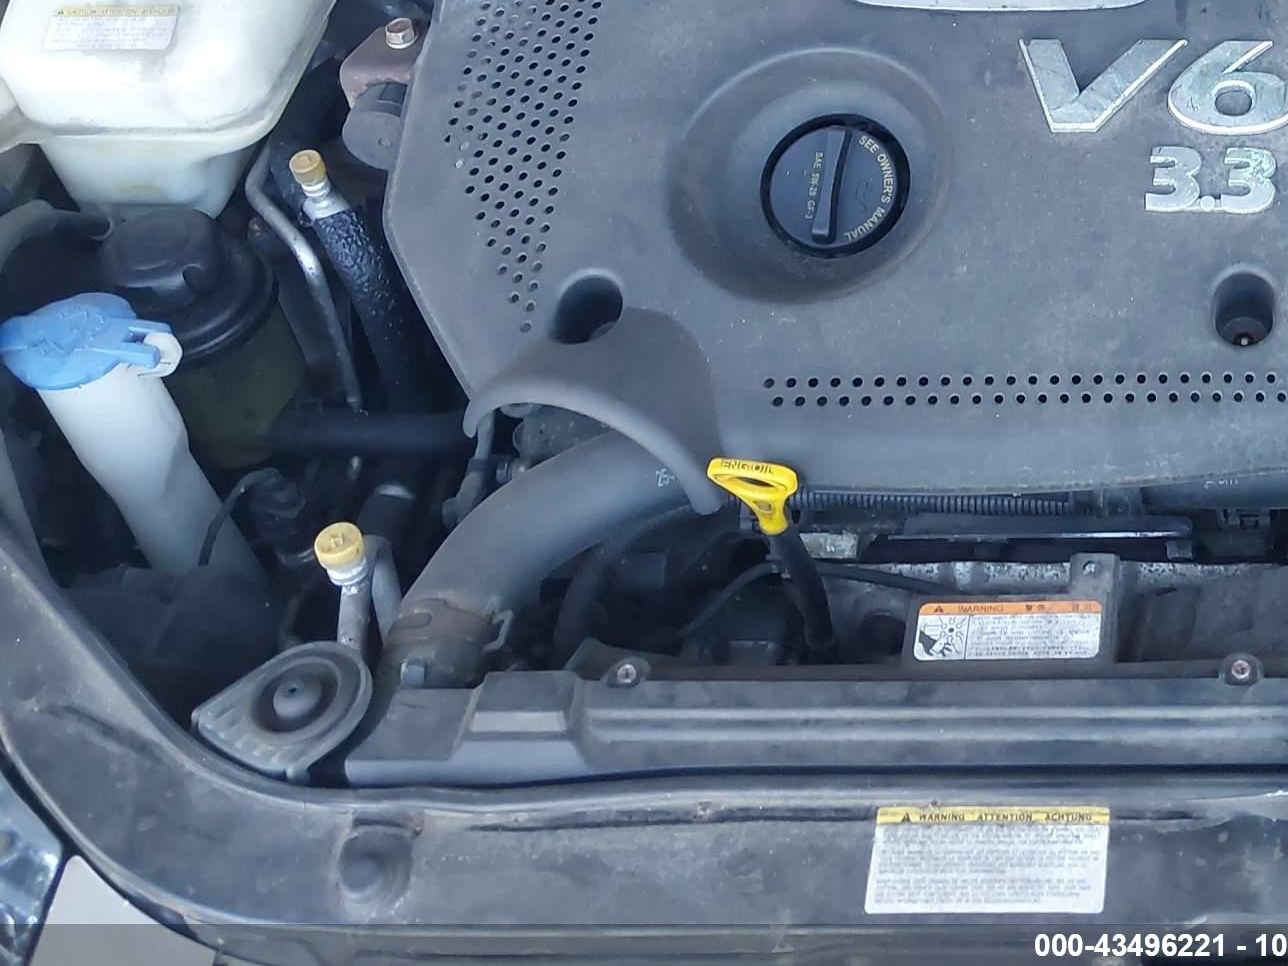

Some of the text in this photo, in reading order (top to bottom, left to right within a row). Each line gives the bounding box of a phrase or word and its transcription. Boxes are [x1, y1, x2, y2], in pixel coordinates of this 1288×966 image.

[845, 135, 893, 242] SEE OWNER'S MANUAL
[1145, 146, 1278, 214] 3.3
[720, 458, 775, 474] ENG OIL
[919, 813, 1093, 821] WARNING ATTENTION ACHTUNG
